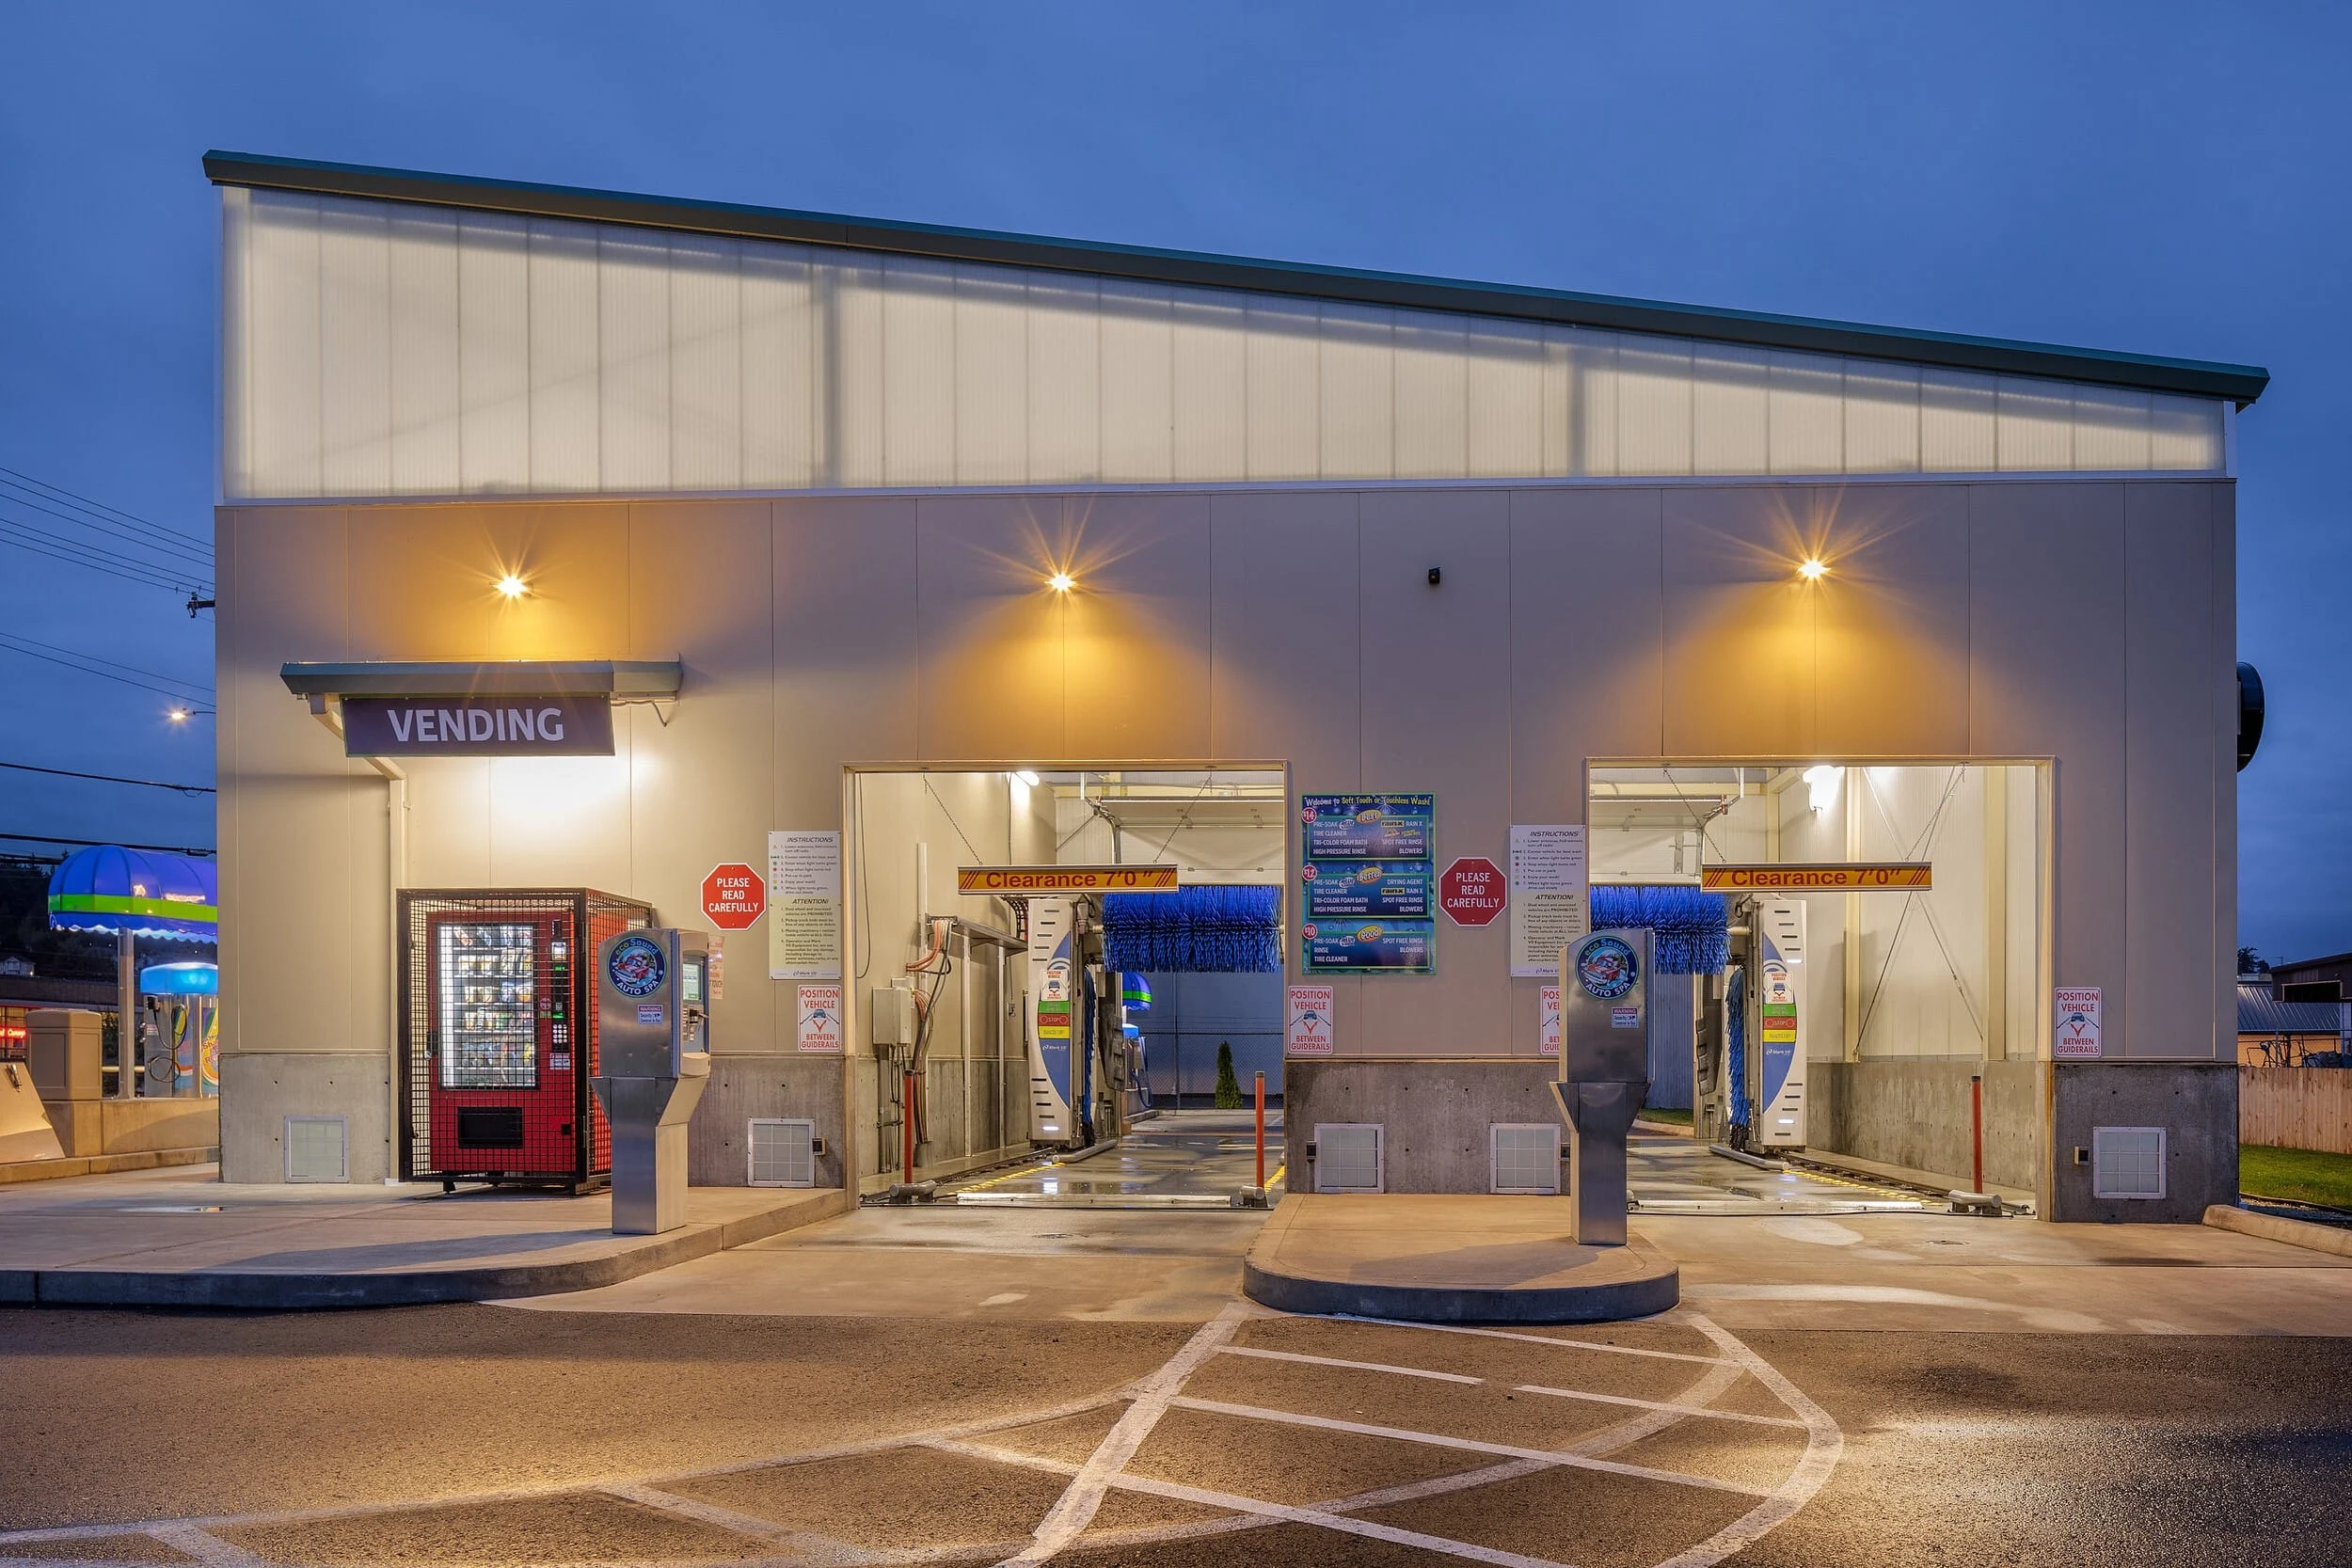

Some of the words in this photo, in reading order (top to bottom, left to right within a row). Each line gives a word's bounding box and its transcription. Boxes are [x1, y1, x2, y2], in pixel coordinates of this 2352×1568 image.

[387, 707, 564, 742] VENDING
[1305, 797, 1331, 806] Welcome
[1333, 798, 1340, 806] to
[1382, 797, 1409, 805] Touchless
[1360, 812, 1378, 821] Best
[1304, 868, 1315, 878] $12
[1455, 872, 1490, 883] PLEASE
[1731, 869, 1847, 886] Clearance
[717, 878, 750, 888] PLEASE
[986, 871, 1097, 888] Clearance
[722, 890, 745, 900] READ
[1461, 885, 1485, 895] READ
[708, 902, 759, 912] CAREFULLY
[1447, 897, 1500, 909] CAREFULLY
[1304, 927, 1315, 936] $10
[1360, 927, 1378, 939] Good
[616, 942, 629, 956] eco
[629, 938, 659, 955] Sound
[1584, 942, 1599, 957] eco
[1600, 939, 1631, 957] Sound
[617, 981, 641, 995] AUTO
[644, 980, 659, 993] SPA
[1586, 983, 1612, 997] AUTO
[1614, 982, 1630, 995] SPA
[801, 990, 838, 999] POSITION
[1290, 990, 1330, 1000] POSITION
[2057, 992, 2098, 1002] POSITION
[804, 1000, 835, 1008] VEHICLE
[1295, 1001, 1327, 1010] VEHICLE
[2061, 1003, 2094, 1012] VEHICLE
[1291, 1042, 1330, 1051] GUIDERAILS
